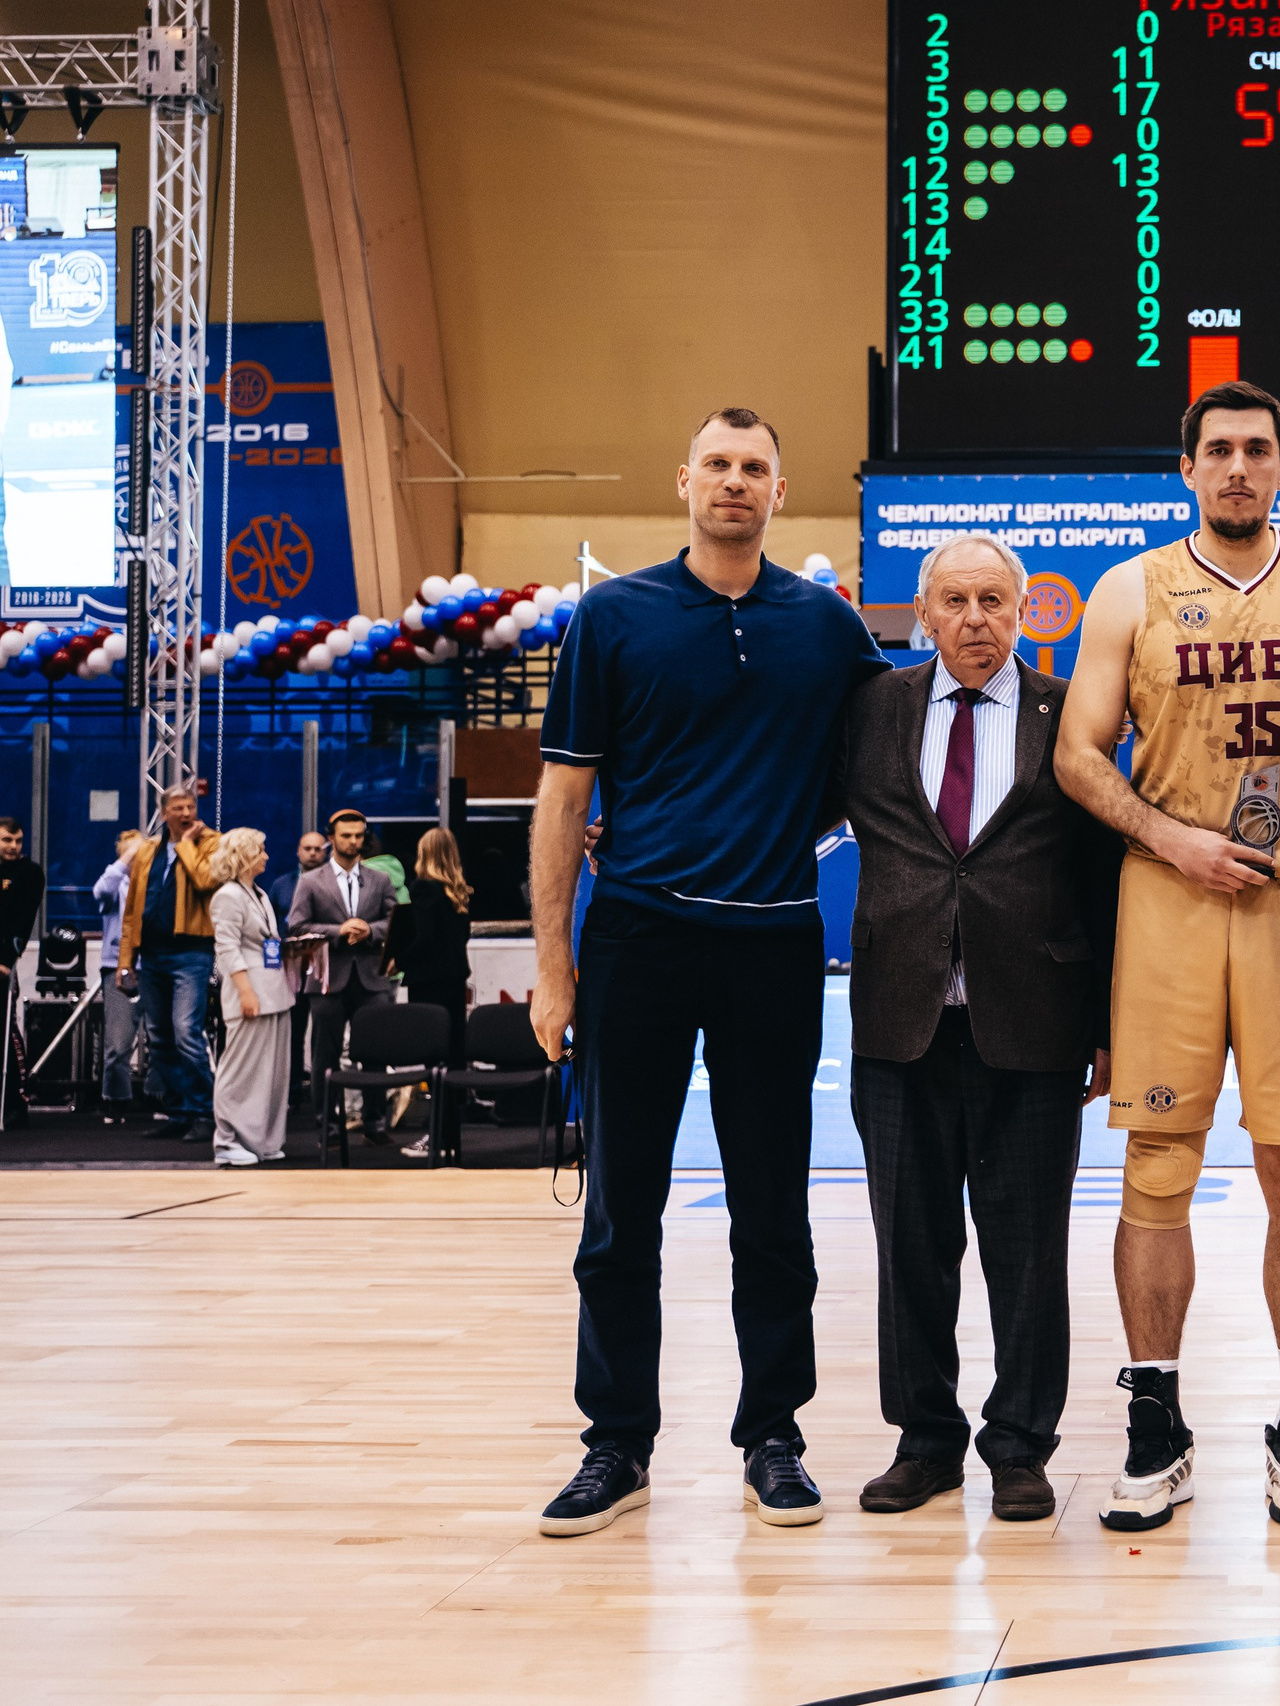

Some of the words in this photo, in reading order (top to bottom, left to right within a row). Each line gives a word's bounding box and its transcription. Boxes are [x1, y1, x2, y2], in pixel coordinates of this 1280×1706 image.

[926, 14, 949, 47] 2
[1137, 10, 1159, 44] 0
[926, 49, 949, 82] 3
[1112, 46, 1154, 79] 11
[926, 85, 949, 118] 5
[1112, 82, 1160, 115] 17
[926, 120, 949, 154] 9
[1137, 117, 1159, 151] 0
[902, 156, 949, 190] 12
[1112, 153, 1159, 187] 13
[902, 192, 949, 225] 13
[1136, 189, 1160, 222] 2
[902, 227, 951, 261] 14
[1137, 225, 1160, 258] 0
[899, 263, 943, 297] 21
[1137, 261, 1160, 294] 0
[899, 299, 949, 333] 33
[1138, 296, 1160, 330] 9
[1187, 308, 1241, 328] ФОЛЫ
[897, 335, 943, 369] 41
[1136, 332, 1160, 366] 2
[206, 423, 309, 443] 2016
[878, 503, 1013, 523] ЧЕМПИОНАТ
[1016, 502, 1190, 524] ЦЕНТРАЛЬНОГО
[1059, 527, 1146, 547] ОКРУГА
